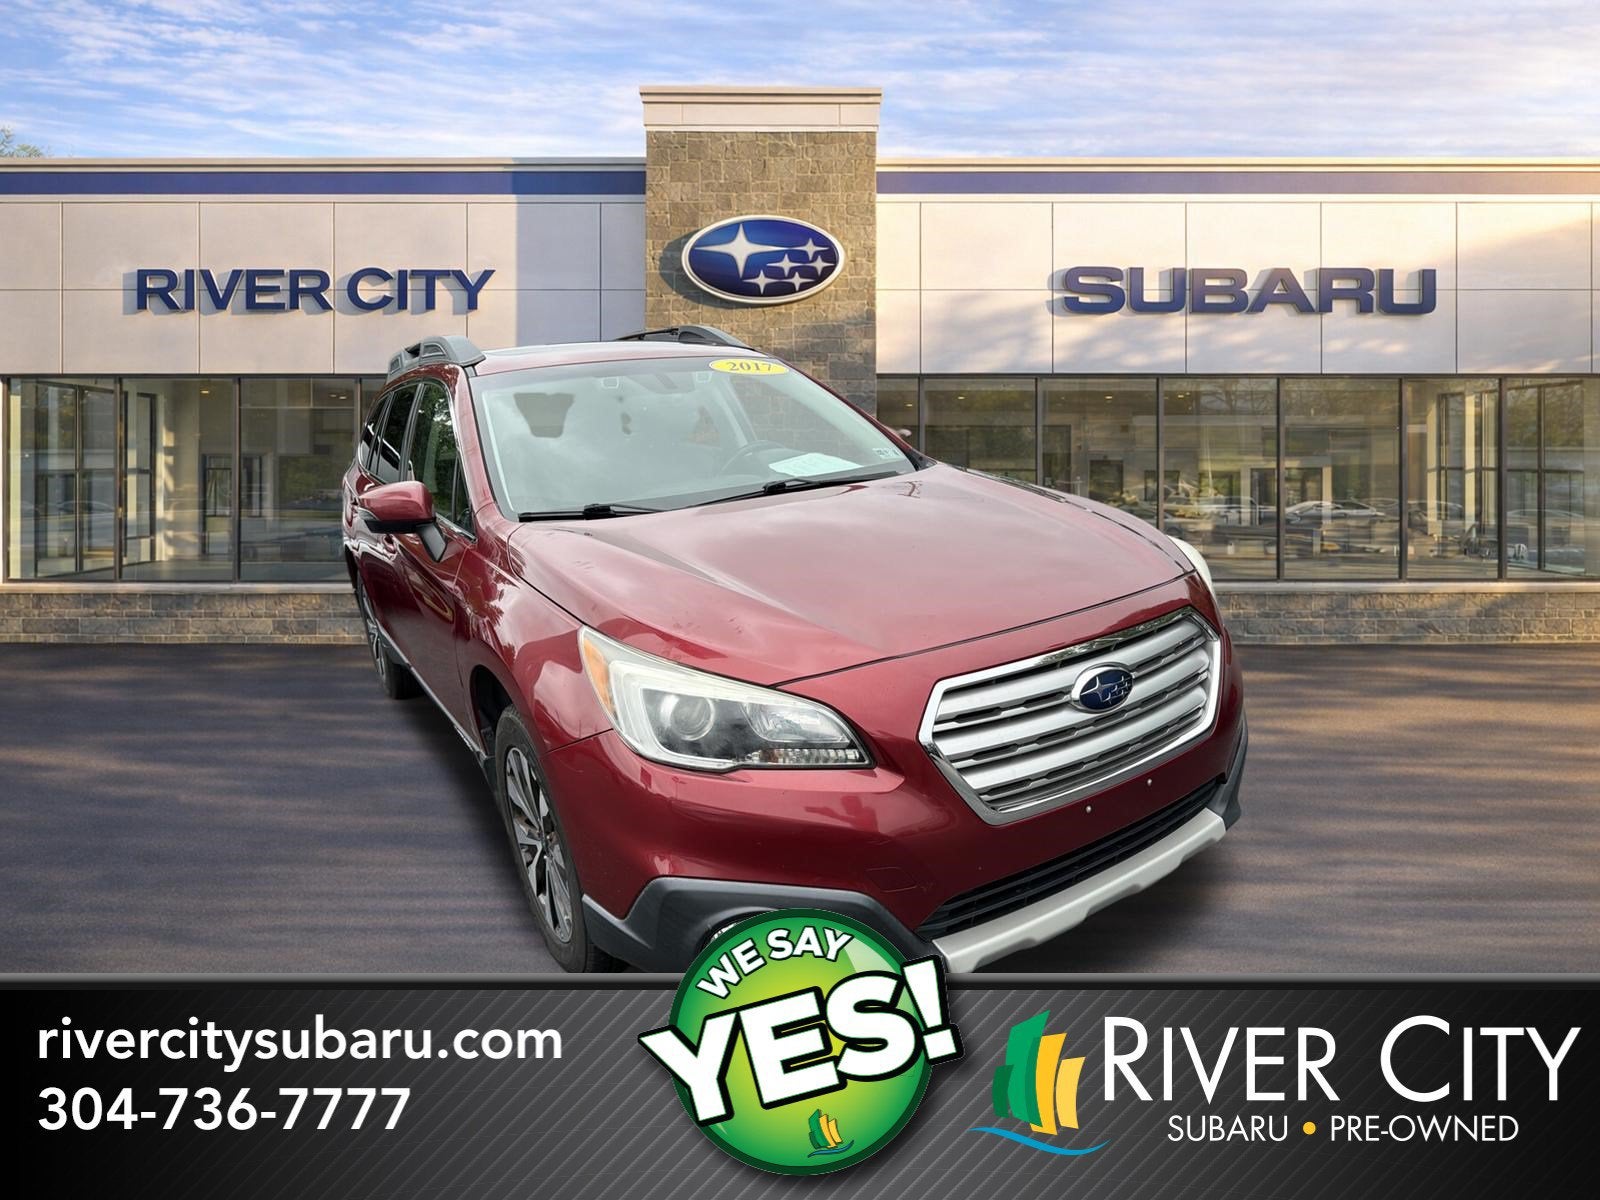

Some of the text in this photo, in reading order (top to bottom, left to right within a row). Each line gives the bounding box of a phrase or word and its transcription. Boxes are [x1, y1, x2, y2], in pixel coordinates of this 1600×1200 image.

[136, 267, 496, 312] RIVER CITY
[1063, 266, 1437, 315] SUBARU
[726, 361, 772, 372] 2017
